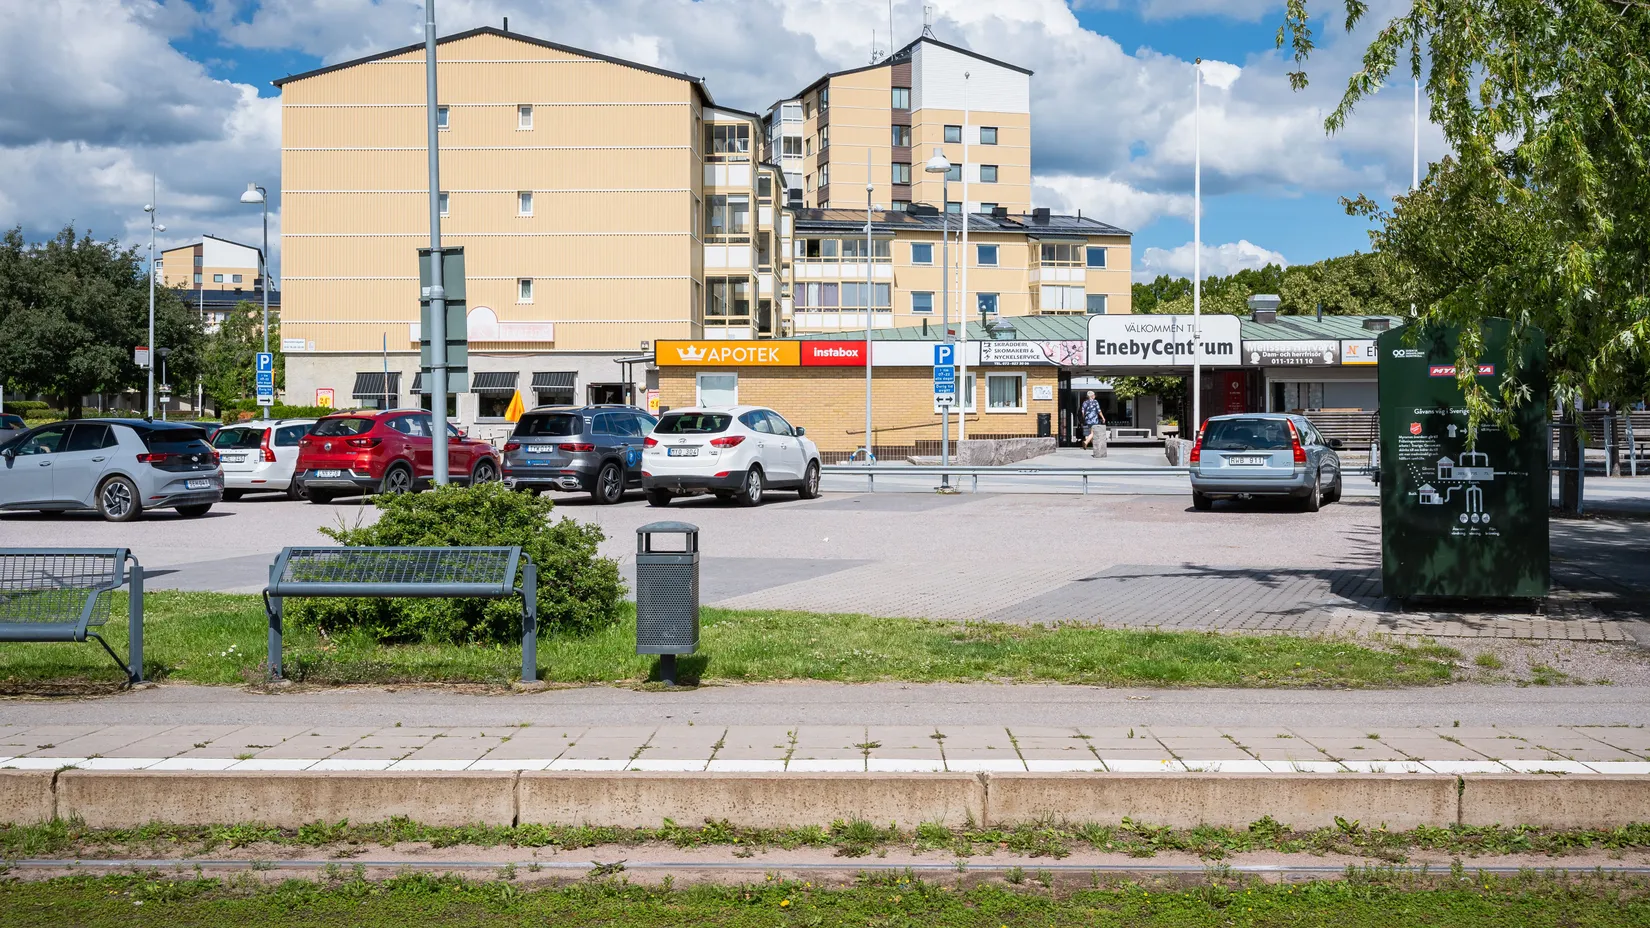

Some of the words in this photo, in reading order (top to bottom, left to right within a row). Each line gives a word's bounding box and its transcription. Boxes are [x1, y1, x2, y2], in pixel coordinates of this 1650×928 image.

[1124, 322, 1184, 333] VÄLKOMMEN
[1187, 324, 1202, 333] TI
[707, 347, 780, 362] APOTEK
[813, 347, 859, 357] instabox
[939, 346, 951, 364] P
[260, 354, 270, 370] P
